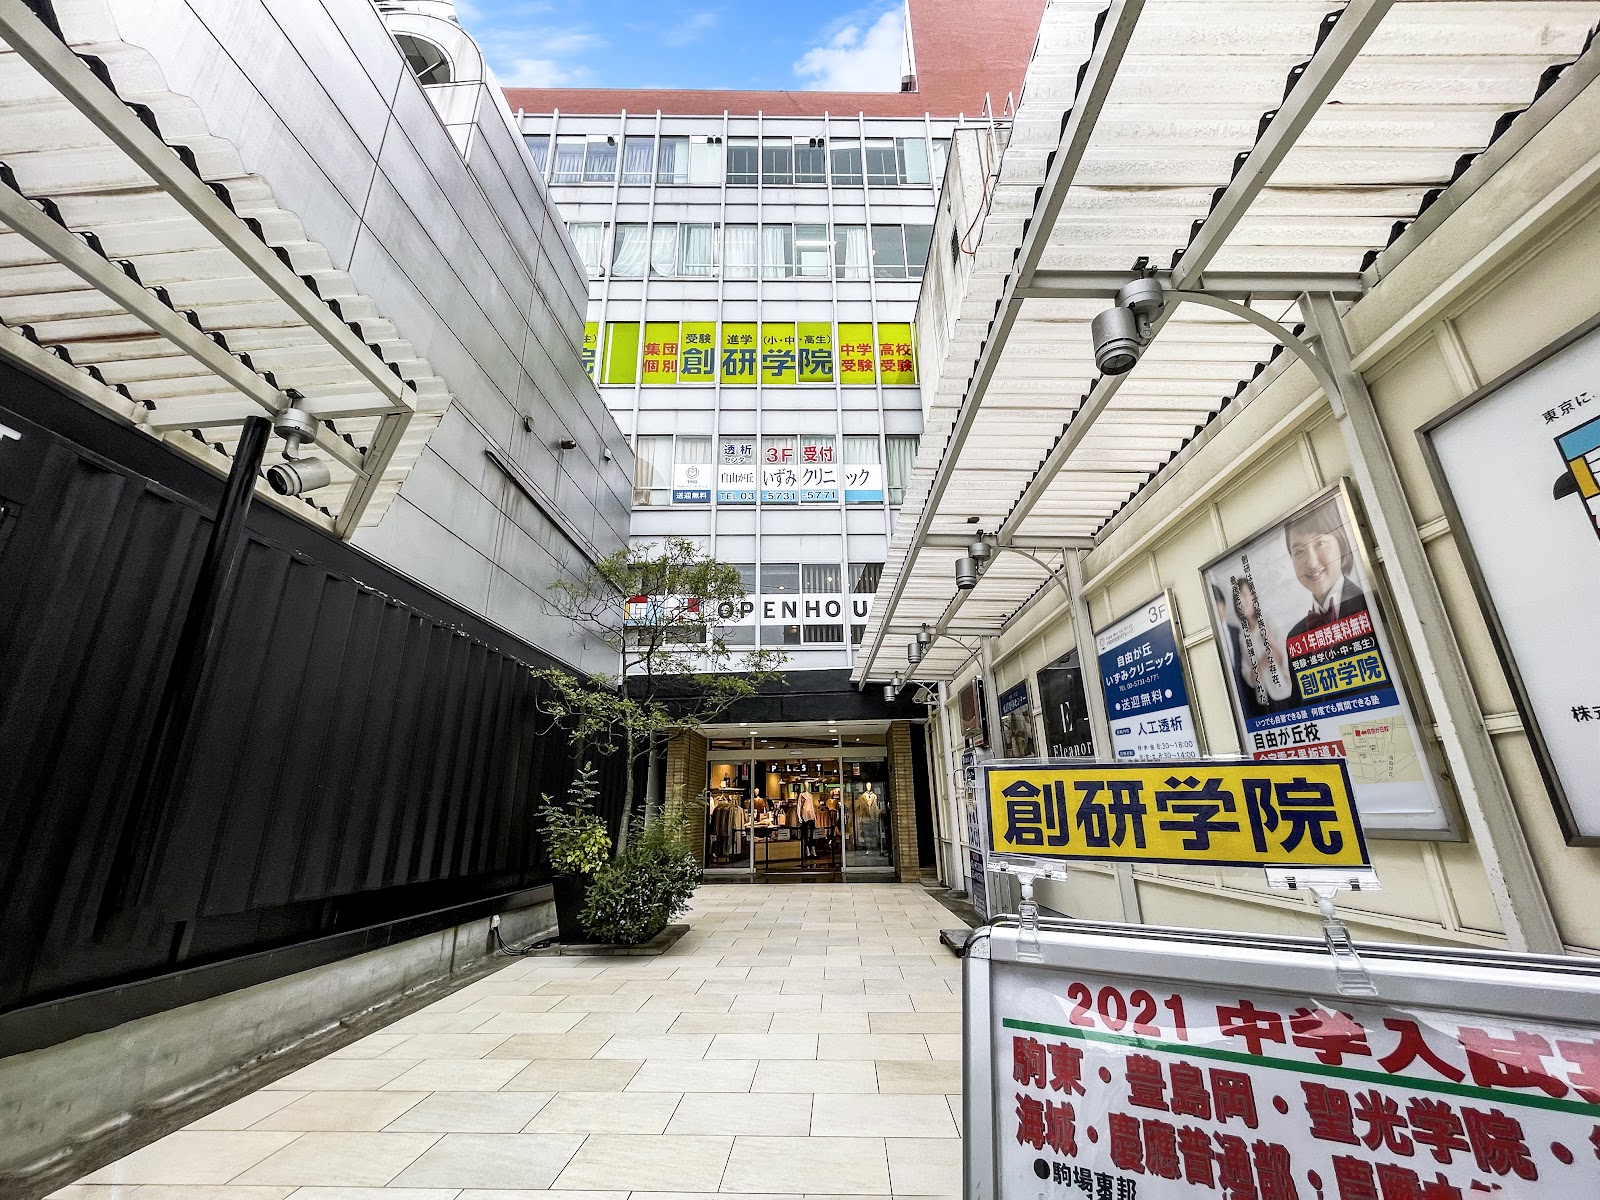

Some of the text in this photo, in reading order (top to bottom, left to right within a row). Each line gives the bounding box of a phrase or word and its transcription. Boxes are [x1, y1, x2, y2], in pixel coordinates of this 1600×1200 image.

[644, 342, 678, 356] 集団
[685, 333, 712, 344] 受験
[727, 334, 753, 345] 進学
[840, 343, 912, 357] 中学 高校
[643, 359, 677, 373] 個別
[680, 347, 833, 376] 創研学院
[841, 359, 913, 372] 受験 受験
[723, 444, 752, 455] 透析
[766, 445, 834, 463] 3F 受付
[1148, 604, 1167, 624] 3F
[1116, 641, 1153, 668] 自由が丘
[1105, 651, 1174, 687] いずみクリニック
[1299, 656, 1382, 696] 創研学院
[1138, 716, 1183, 736] 人工透析
[1253, 722, 1321, 750] 自由が丘校
[1053, 741, 1093, 760] Eleanor
[1001, 775, 1344, 856] 創研学院
[1067, 982, 1189, 1042] 2021
